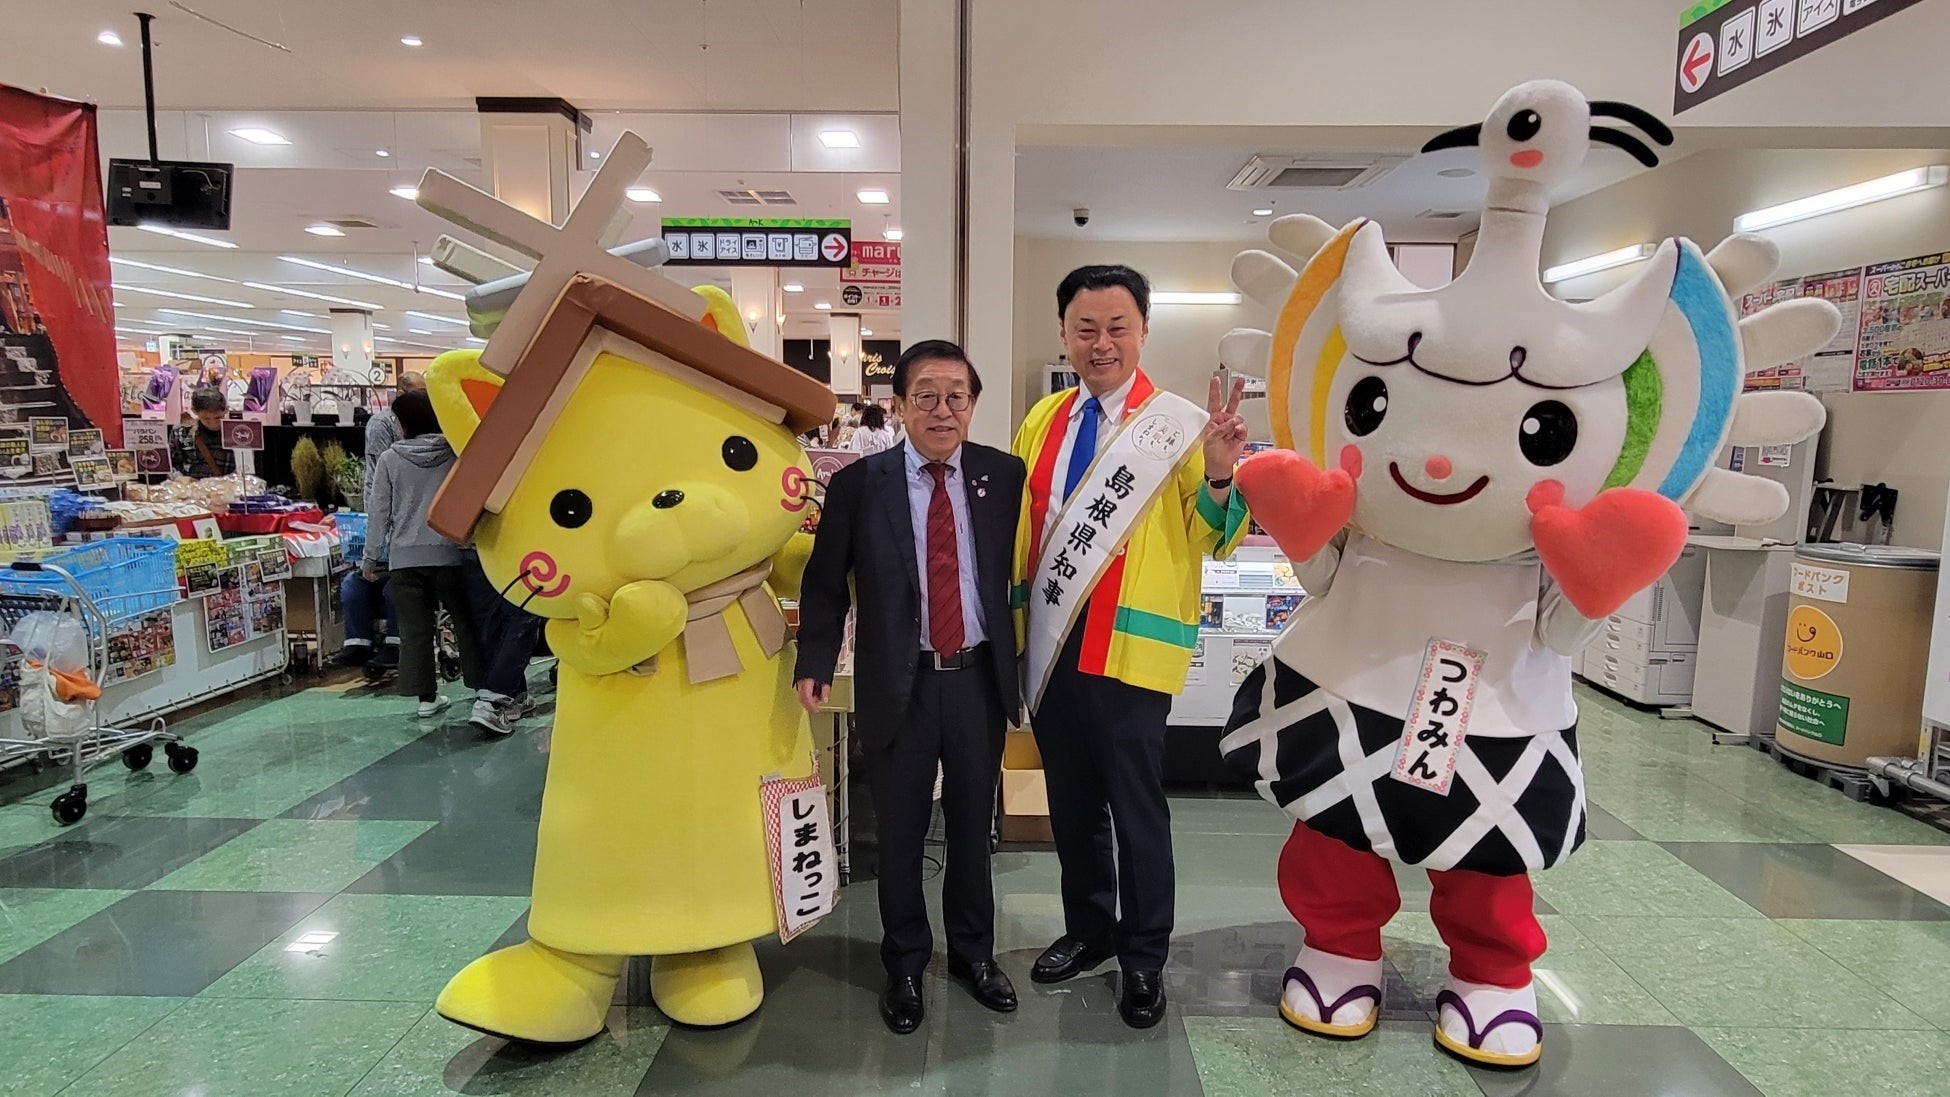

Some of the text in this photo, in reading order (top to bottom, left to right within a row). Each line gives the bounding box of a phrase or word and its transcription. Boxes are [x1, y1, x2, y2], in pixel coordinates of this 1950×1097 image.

[1766, 9, 1784, 36] 氷
[1727, 28, 1744, 56] 水
[671, 240, 683, 251] 水
[697, 240, 709, 251] 氷
[719, 247, 738, 255] アイス
[373, 370, 381, 382] 2
[1042, 464, 1135, 607] 島根県知事
[1408, 658, 1467, 779] つわみん
[792, 798, 823, 916] しまねっこ
